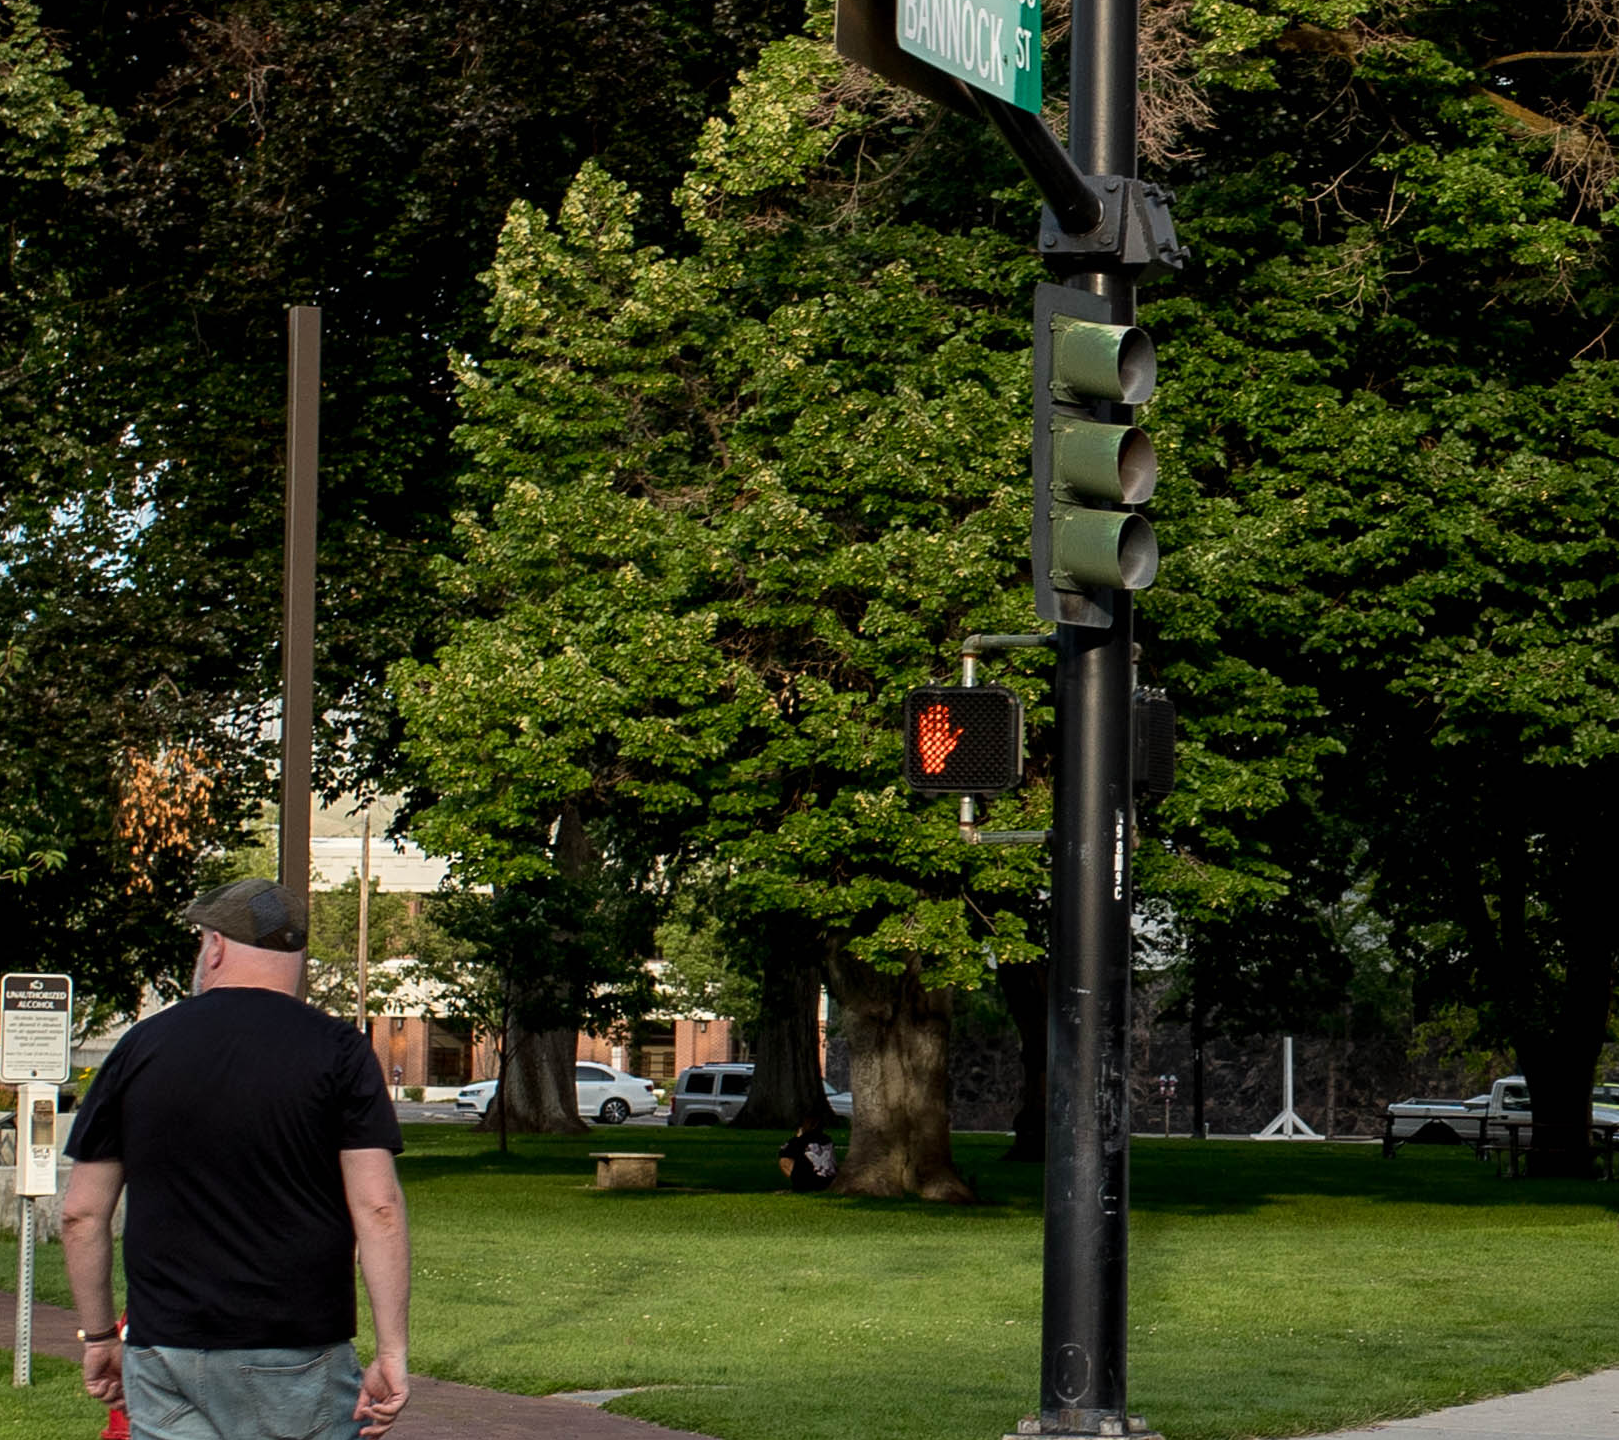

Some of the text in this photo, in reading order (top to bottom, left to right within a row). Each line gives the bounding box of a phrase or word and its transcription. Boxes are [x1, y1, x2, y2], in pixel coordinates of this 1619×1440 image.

[1015, 27, 1032, 72] ST
[6, 991, 67, 1000] UNAUTHORIZED
[17, 1001, 55, 1009] ALCOHOL
